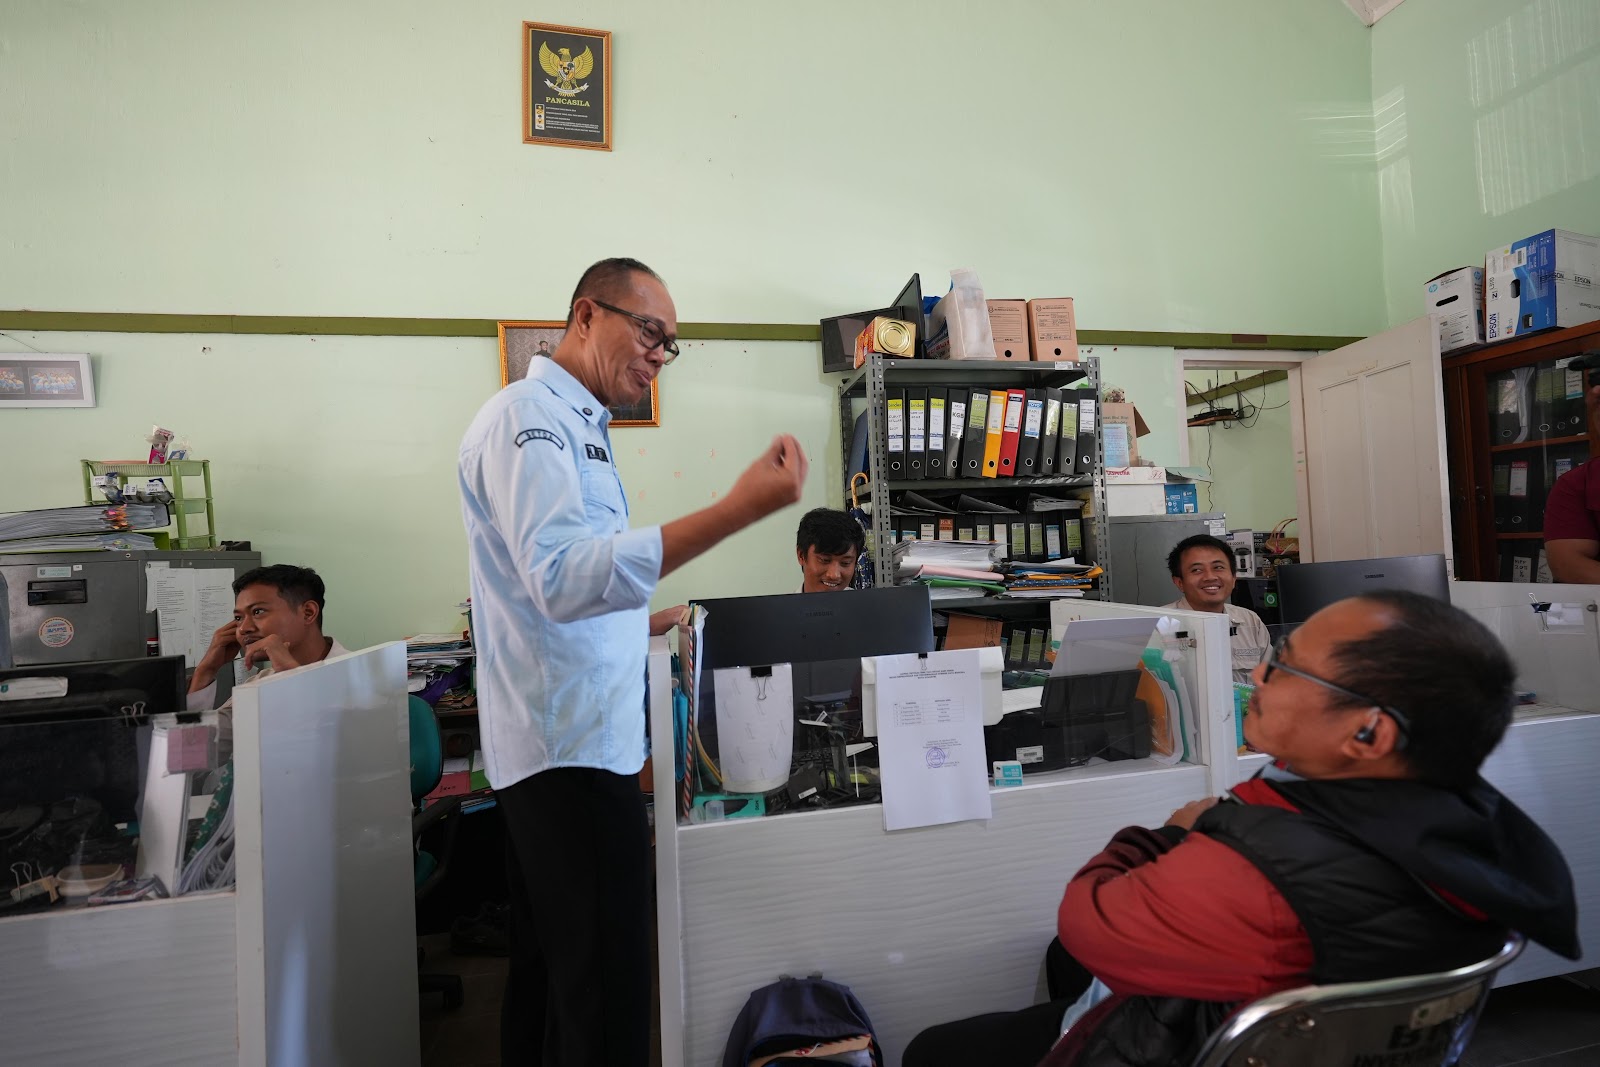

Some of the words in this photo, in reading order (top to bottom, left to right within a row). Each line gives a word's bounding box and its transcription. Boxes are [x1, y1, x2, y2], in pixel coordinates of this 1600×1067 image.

[545, 96, 591, 107] PANCASILA
[1574, 275, 1592, 285] EPSON
[1489, 313, 1497, 339] EPSON
